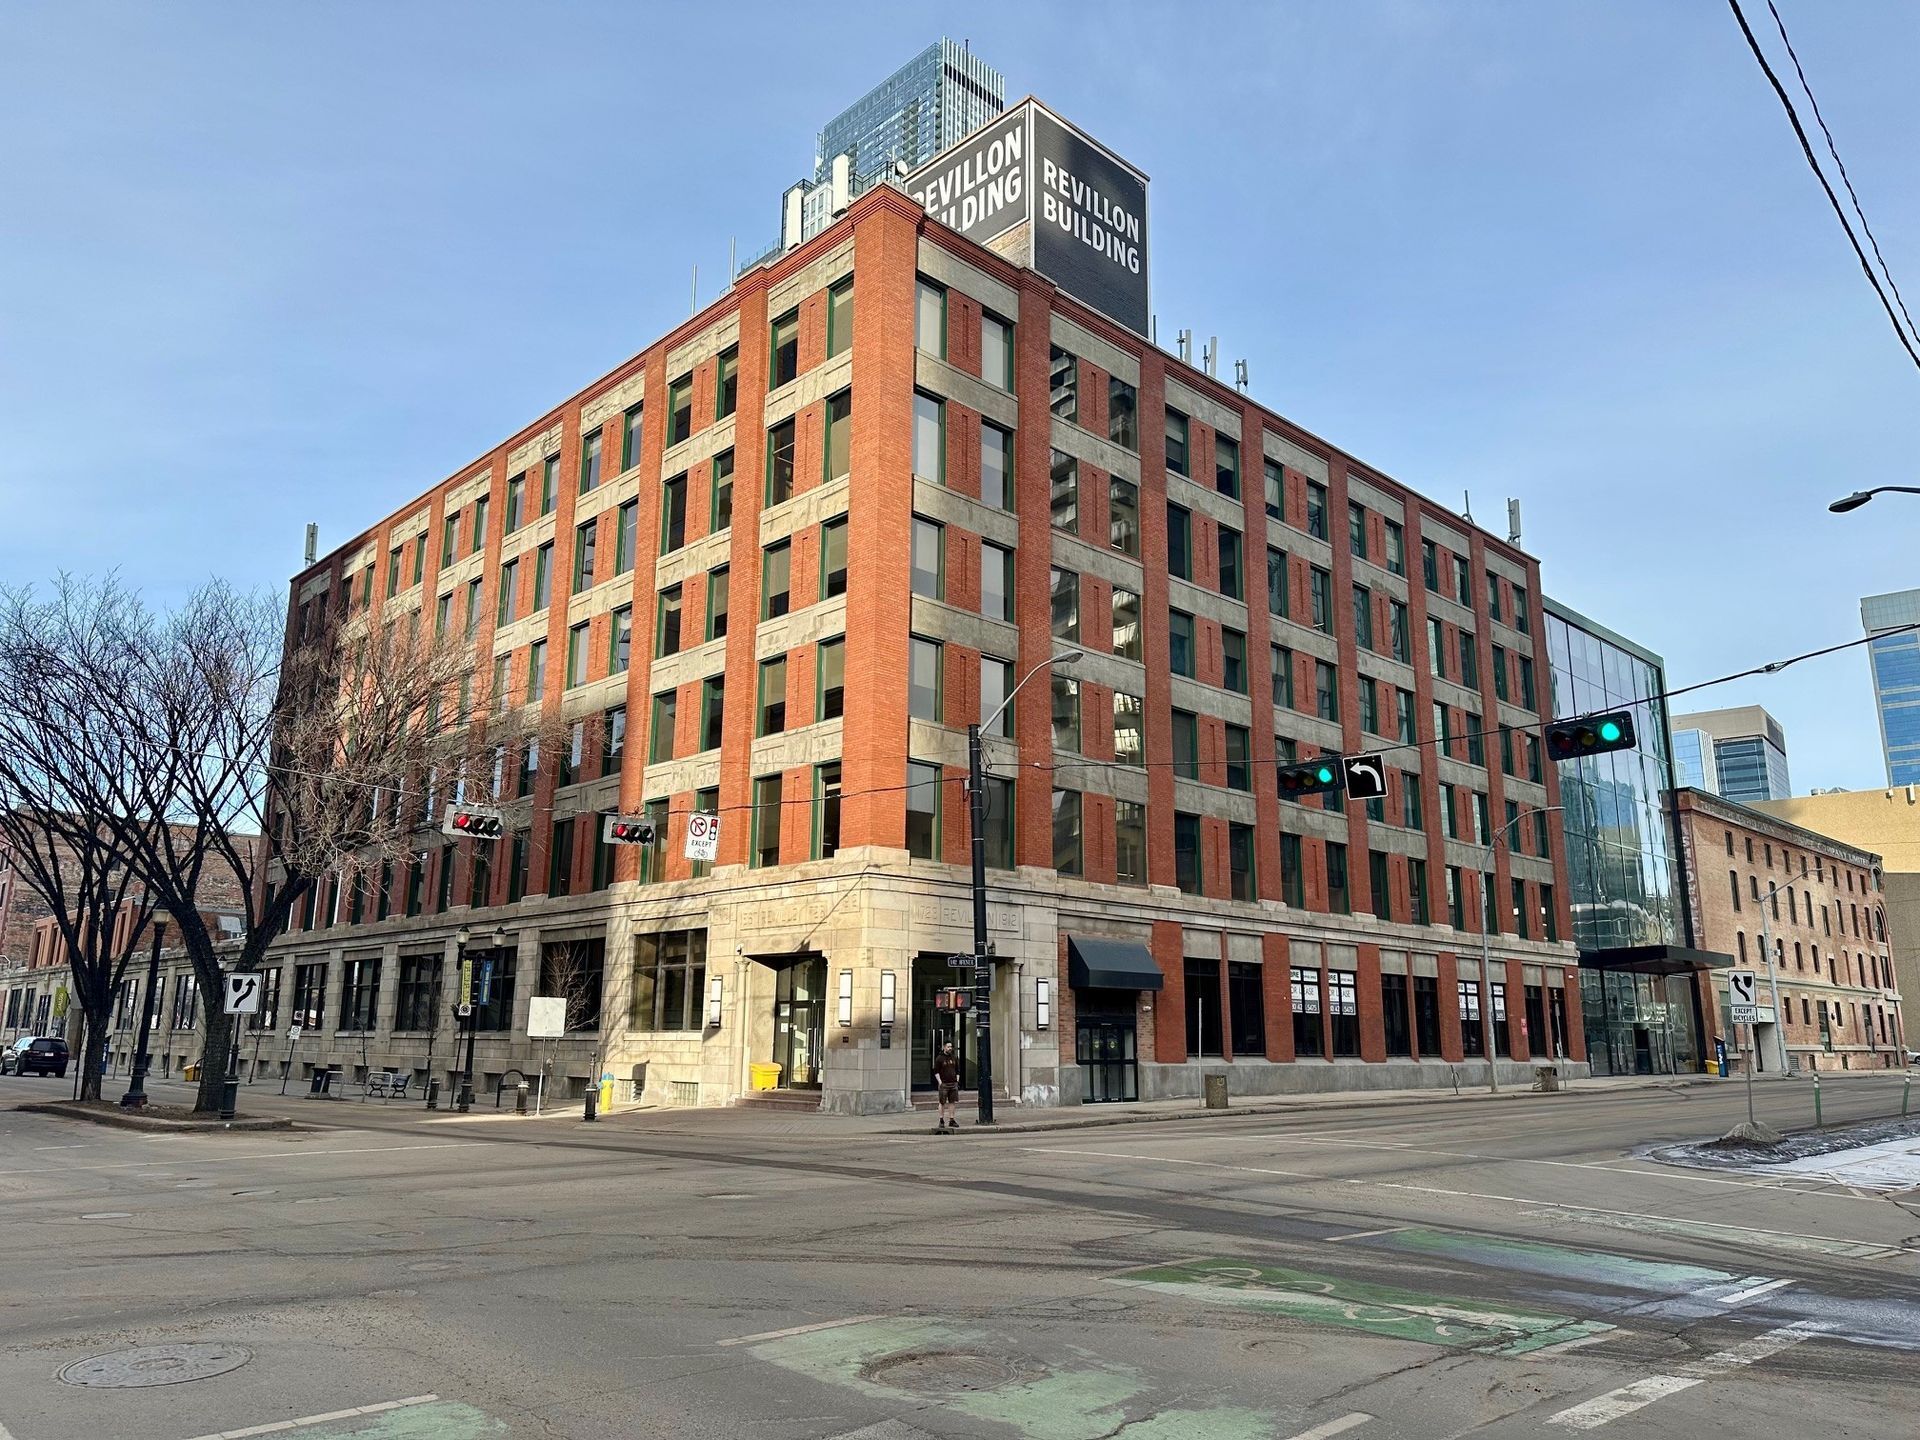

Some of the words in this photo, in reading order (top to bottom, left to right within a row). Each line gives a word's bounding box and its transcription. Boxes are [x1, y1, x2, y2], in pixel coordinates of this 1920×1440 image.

[937, 166, 1022, 232] LDING
[1043, 157, 1139, 243] REVILLON
[1043, 191, 1140, 275] BUILDING
[691, 840, 712, 848] EXCEPT
[943, 907, 995, 926] REVILN
[998, 912, 1017, 927] 1912
[1733, 1014, 1756, 1022] BICYCLES
